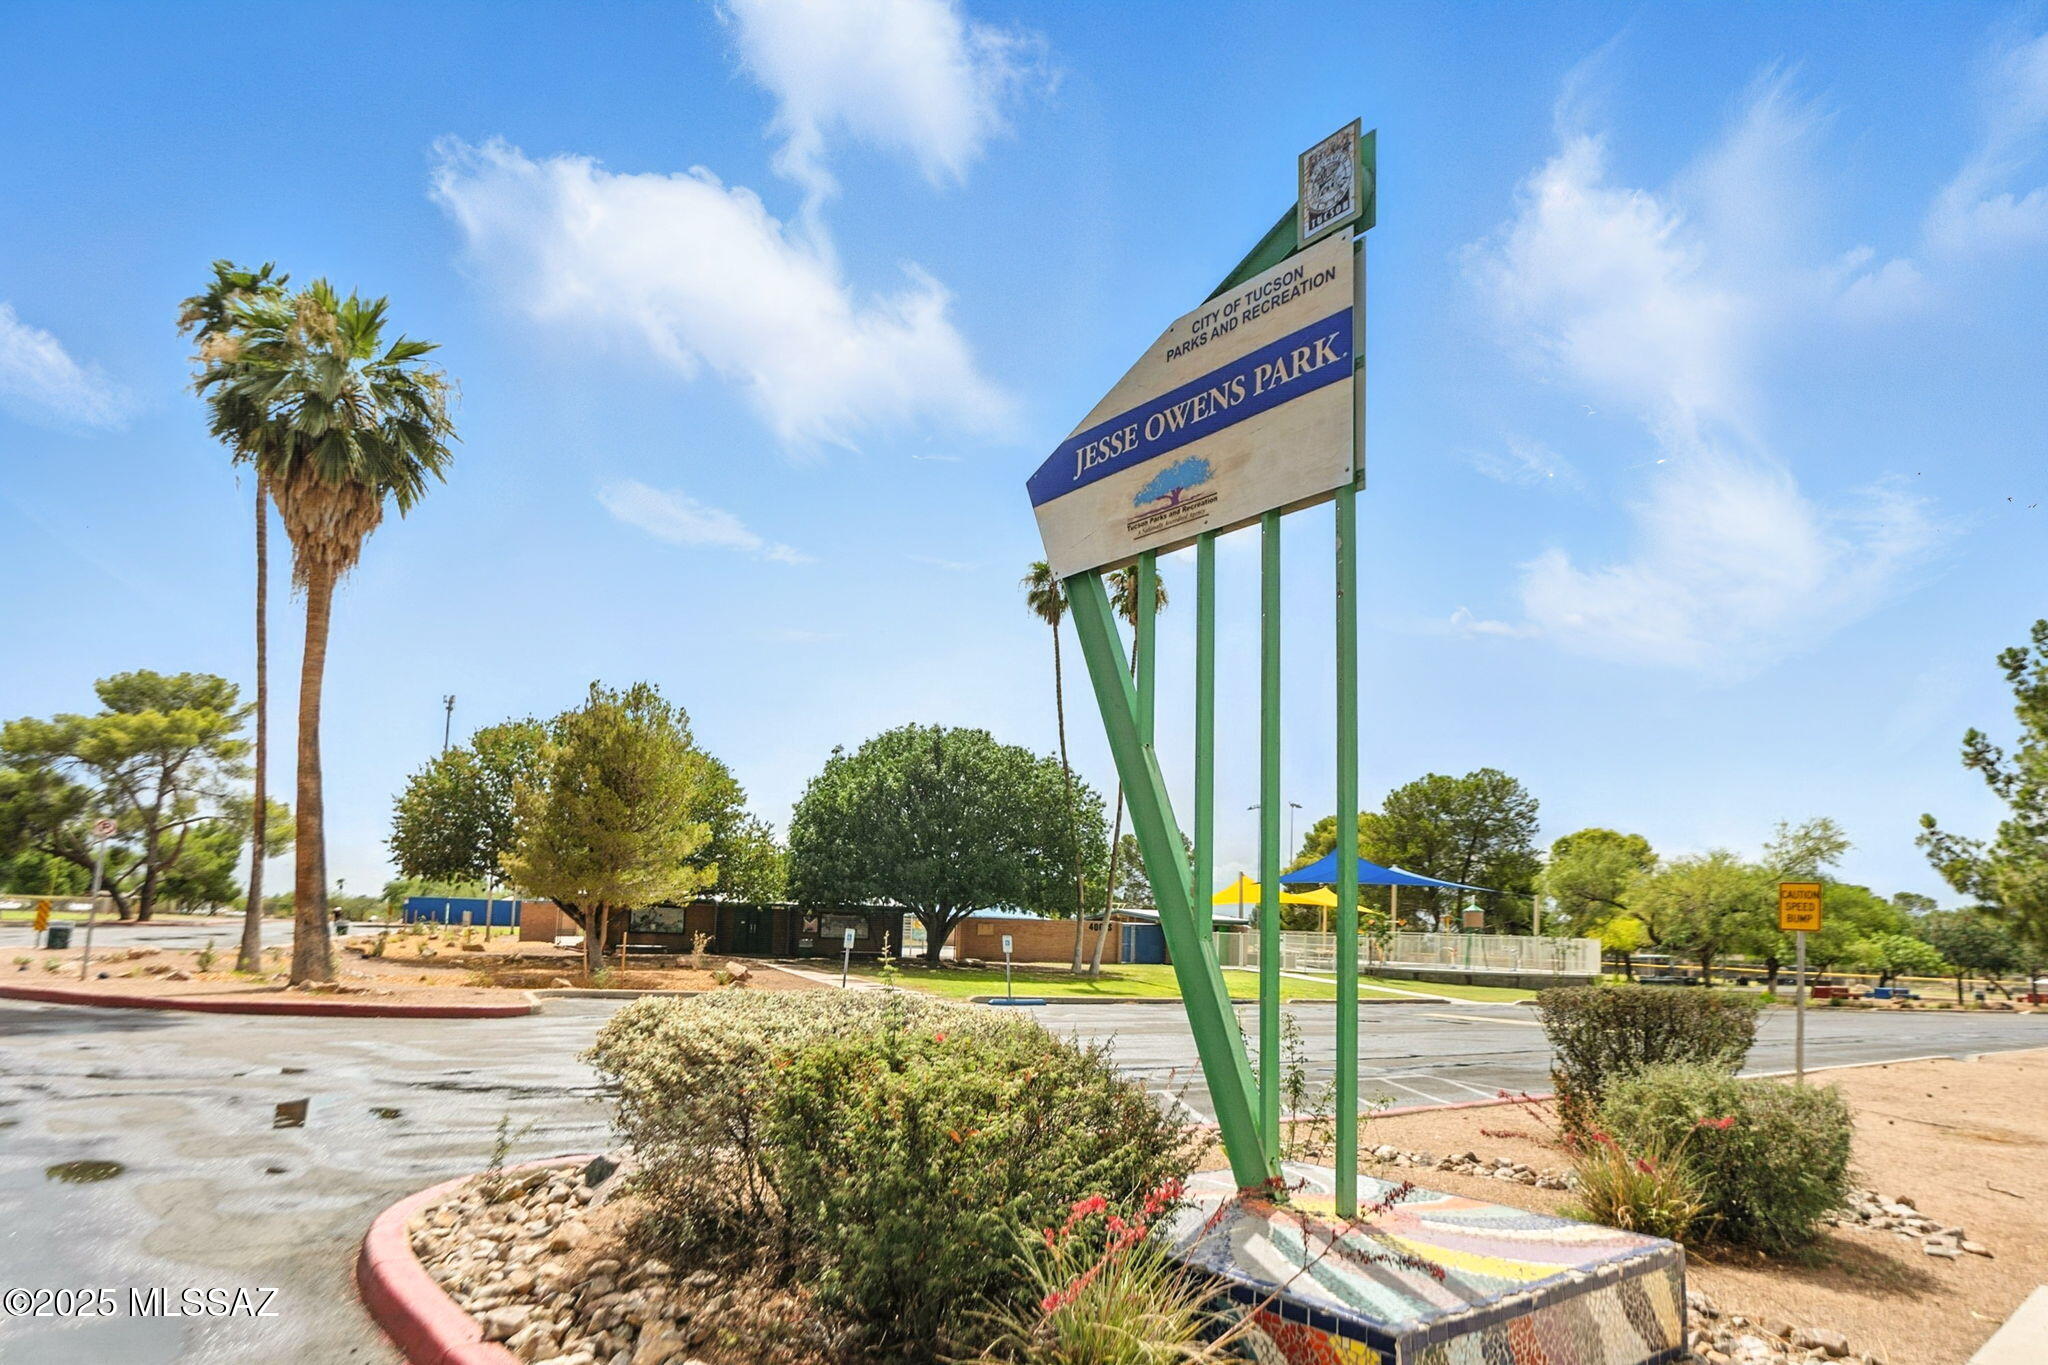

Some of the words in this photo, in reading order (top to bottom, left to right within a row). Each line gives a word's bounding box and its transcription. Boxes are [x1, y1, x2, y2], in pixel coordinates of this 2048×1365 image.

[1310, 200, 1350, 229] TUCSON
[1166, 332, 1208, 363] PARKS
[1210, 316, 1238, 341] AND
[1242, 266, 1336, 325] RECREATION
[1192, 309, 1220, 334] CITY
[1223, 298, 1242, 318] OF
[1245, 265, 1304, 302] TUCSON
[1073, 423, 1139, 481] JESSE
[1144, 375, 1246, 442] OWENS
[1253, 331, 1341, 397] PARK
[1127, 520, 1149, 532] Tucson
[1149, 514, 1167, 524] Parks
[1168, 508, 1181, 517] and
[1182, 496, 1218, 513] Recreation
[1782, 889, 1820, 899] CAUTION
[1785, 902, 1816, 912] SPEED
[1786, 913, 1813, 923] BUMP
